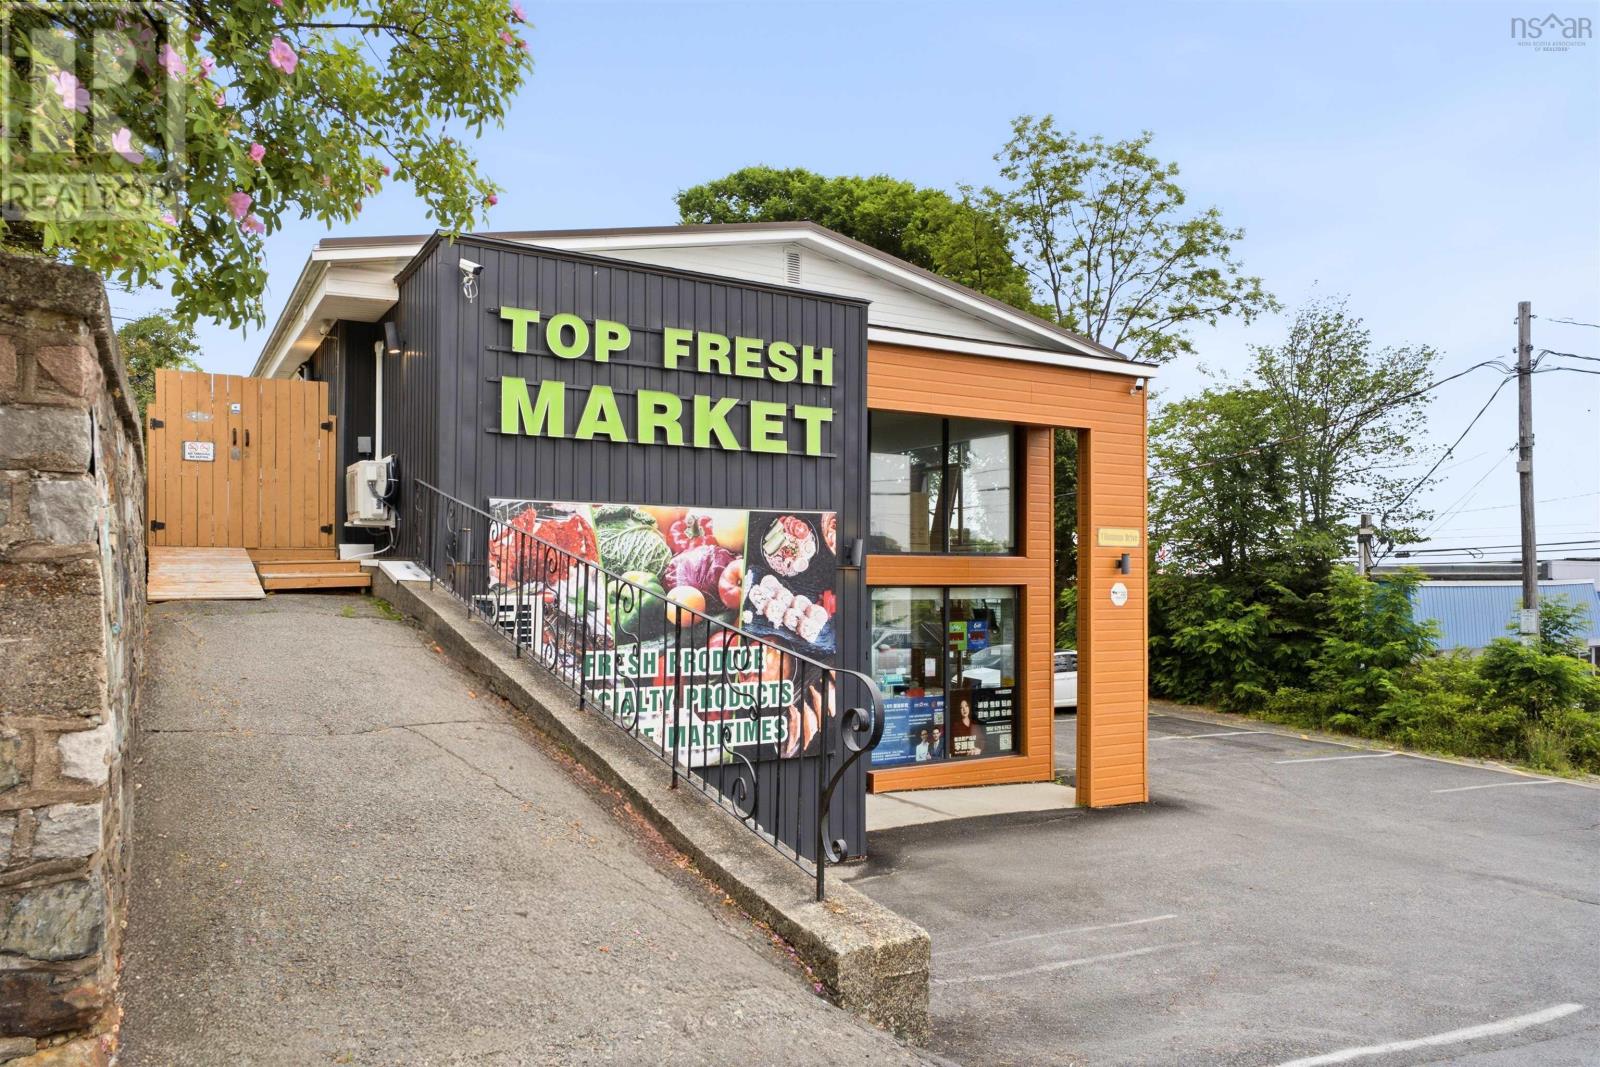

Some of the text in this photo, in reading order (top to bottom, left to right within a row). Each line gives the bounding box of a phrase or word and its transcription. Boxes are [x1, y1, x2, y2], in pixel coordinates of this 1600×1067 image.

[500, 306, 833, 386] TOP FRESH
[501, 376, 833, 456] MARKET
[584, 648, 764, 677] FRESH PRODUCE
[686, 682, 792, 710] PRODUCTS
[668, 718, 786, 748] MARITIMES
